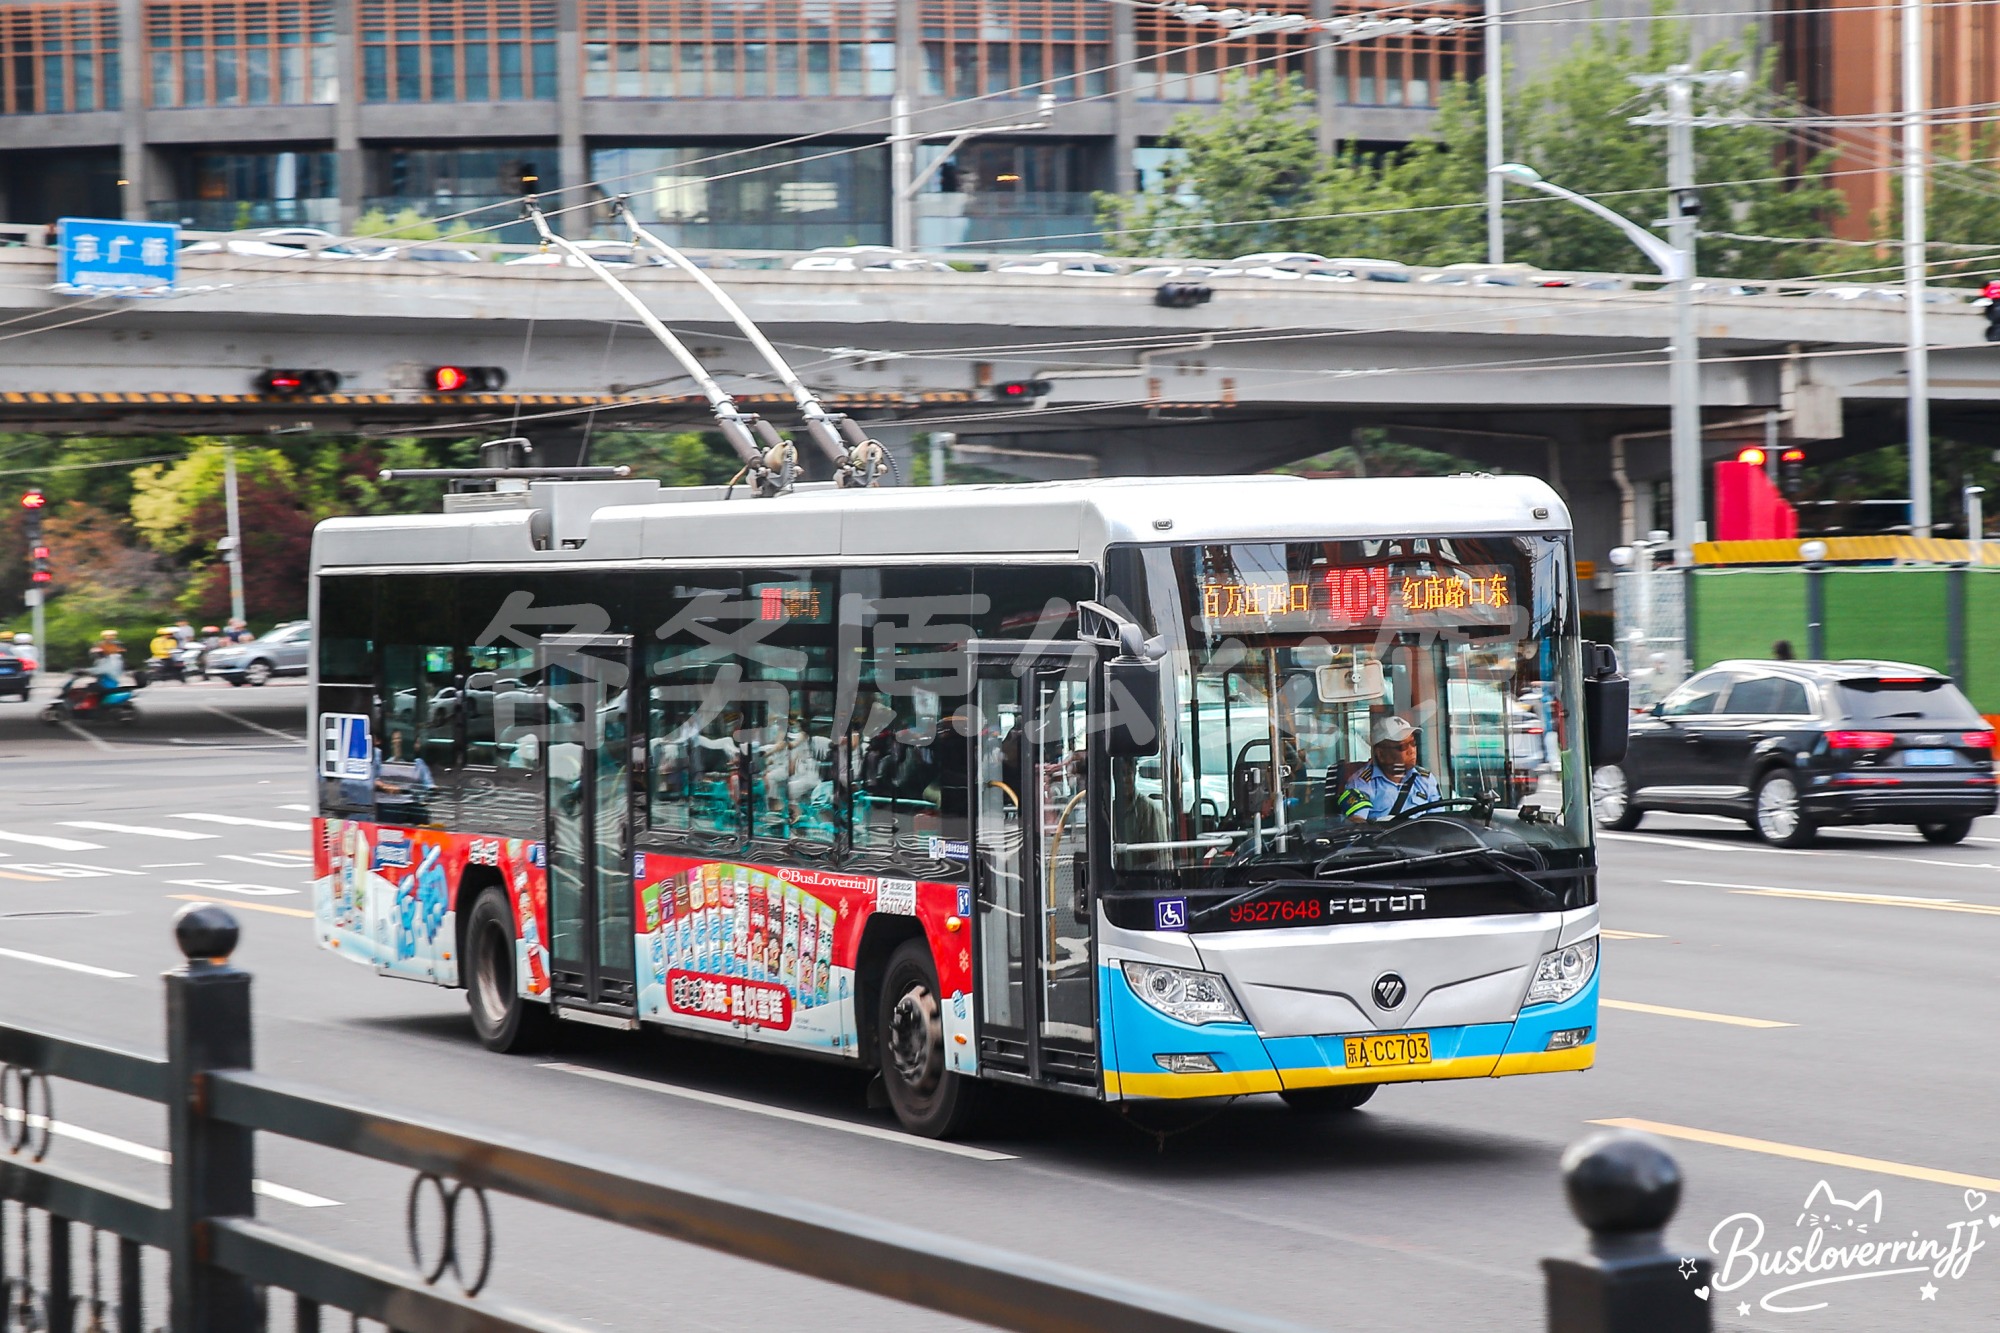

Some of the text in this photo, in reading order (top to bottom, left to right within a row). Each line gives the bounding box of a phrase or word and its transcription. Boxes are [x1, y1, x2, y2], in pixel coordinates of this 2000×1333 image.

[1202, 583, 1309, 618] 百万庄西口
[1325, 567, 1387, 621] 101
[1402, 573, 1510, 611] 红庙路口东
[1229, 893, 1427, 923] 9527648 FOTON
